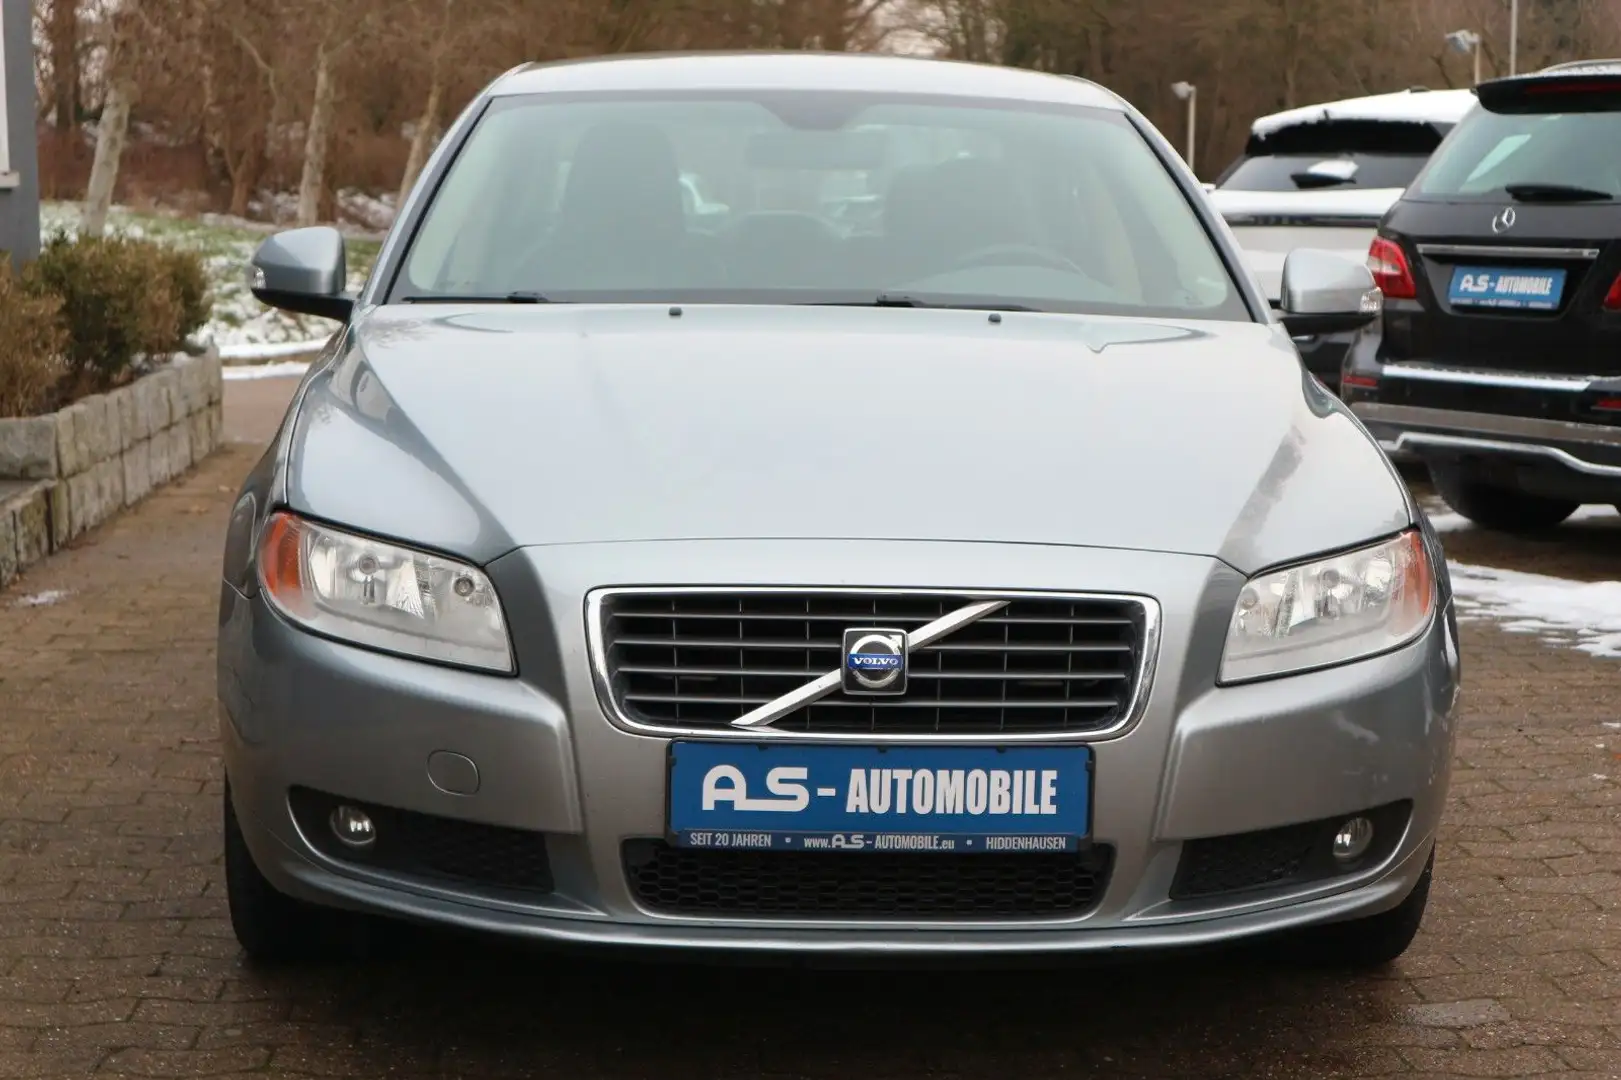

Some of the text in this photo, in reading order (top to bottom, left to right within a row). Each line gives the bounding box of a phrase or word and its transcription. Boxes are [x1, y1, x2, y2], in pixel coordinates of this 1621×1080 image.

[853, 657, 899, 665] VOLVO
[846, 768, 1057, 815] AUTOMOBILE
[690, 832, 712, 846] SEIT
[715, 833, 729, 846] 20
[731, 834, 771, 847] JAHREN
[986, 836, 1066, 850] HIDDENHAUSEN
